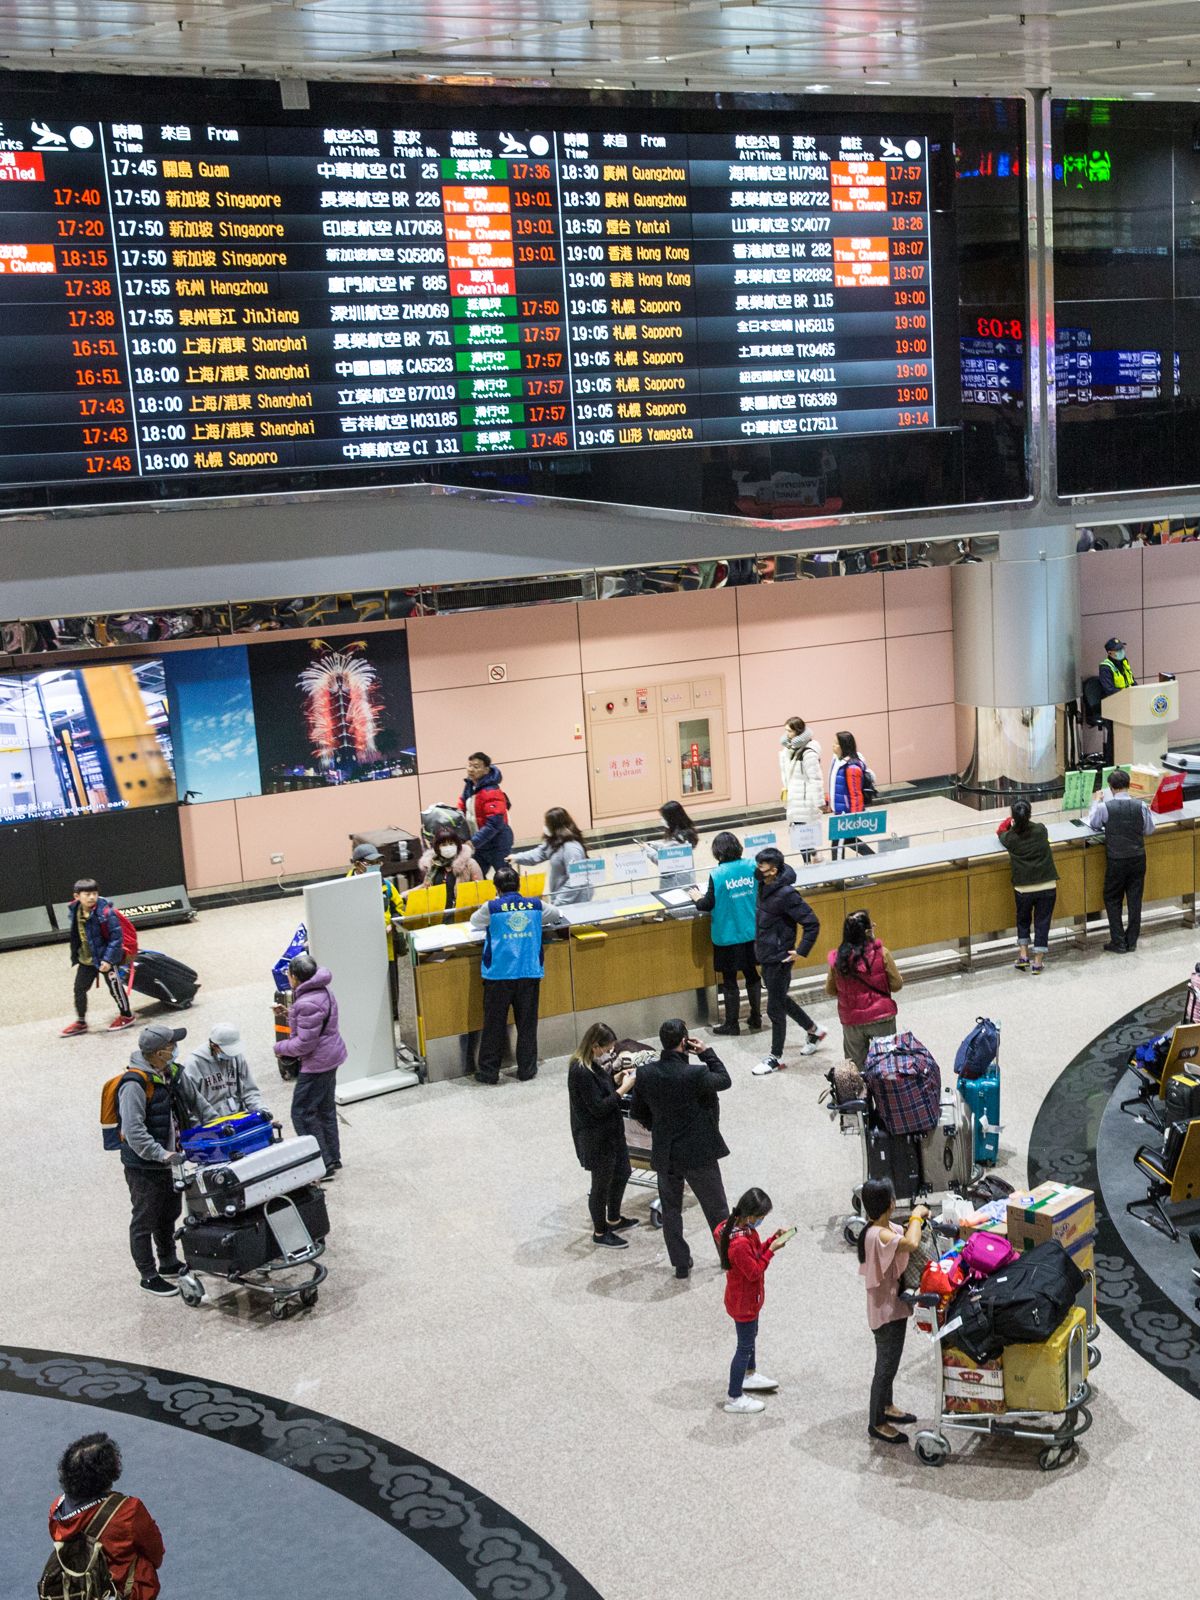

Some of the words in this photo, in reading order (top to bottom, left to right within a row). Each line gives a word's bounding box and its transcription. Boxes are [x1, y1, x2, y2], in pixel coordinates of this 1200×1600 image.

[161, 125, 191, 141] 來自
[208, 126, 239, 142] From
[640, 134, 666, 148] From
[111, 160, 157, 176] 17:45
[199, 162, 229, 178] Guam
[317, 162, 387, 180] 中華航空
[390, 164, 406, 179] CI
[422, 164, 438, 179] 25
[512, 164, 550, 180] 17:36
[562, 165, 599, 180] 18:30
[632, 166, 686, 181] Guangzhou
[789, 166, 828, 180] HU7981
[890, 166, 922, 180] 17:57
[54, 190, 100, 206] 17:40
[114, 190, 160, 206] 17:50
[166, 190, 210, 208] 新加坡
[216, 192, 281, 209] Singapore
[320, 192, 390, 208] 長榮航空
[392, 192, 409, 207] BR
[416, 192, 440, 207] 226
[514, 192, 552, 207] 19:01
[57, 220, 104, 236] 17:20
[565, 219, 602, 234] 18:50
[636, 219, 670, 234] Yantai
[791, 218, 830, 232] SC4077
[892, 218, 923, 231] 18:26
[62, 250, 108, 266] 18:15
[567, 246, 604, 261] 19:00
[608, 246, 632, 262] 香港
[637, 246, 661, 261] Hong
[665, 246, 690, 261] Kong
[792, 244, 806, 257] HX
[811, 243, 832, 257] 282
[892, 242, 924, 256] 18:07
[125, 280, 170, 296] 17:55
[176, 280, 205, 296] 杭州
[211, 280, 268, 296] Hangzhou
[422, 276, 447, 291] 885
[570, 300, 607, 314] 19:05
[611, 299, 636, 314] 札幌
[640, 300, 682, 314] Sapporo
[736, 295, 792, 310] 長榮航空
[794, 294, 808, 308] BR
[813, 294, 834, 307] 115
[894, 292, 926, 305] 19:00
[128, 310, 174, 326] 17:55
[243, 309, 299, 324] JinJiang
[330, 305, 400, 322] 深圳航空
[402, 304, 449, 320] ZH9069
[522, 301, 559, 316] 17:50
[406, 358, 453, 374] CA5523
[526, 354, 562, 368] 17:57
[135, 368, 180, 384] 18:00
[186, 366, 249, 384] 上海/浦東
[256, 366, 310, 382] Shanghai
[338, 388, 406, 405] 立榮航空
[408, 385, 456, 401] B77019
[528, 380, 564, 396] 17:57
[80, 399, 125, 416] 17:43
[139, 398, 183, 413] 18:00
[189, 394, 252, 412] 上海/浦東
[258, 394, 312, 410] Shanghai
[741, 421, 798, 436] 中華航空
[799, 418, 838, 432] CI7511
[898, 412, 930, 426] 19:14
[578, 430, 614, 445] 19:05
[618, 429, 642, 444] 山形
[647, 427, 694, 442] Yamagata
[342, 442, 410, 460] 中華航空
[412, 440, 429, 456] CI
[435, 439, 459, 454] 131
[531, 432, 568, 448] 17:45
[145, 454, 188, 470] 18:00
[195, 453, 222, 469] 札幌
[229, 453, 278, 468] Sapporo
[4, 812, 26, 822] who
[28, 808, 52, 818] have
[108, 800, 130, 810] early
[837, 814, 878, 832] kkday
[726, 876, 755, 890] kkday
